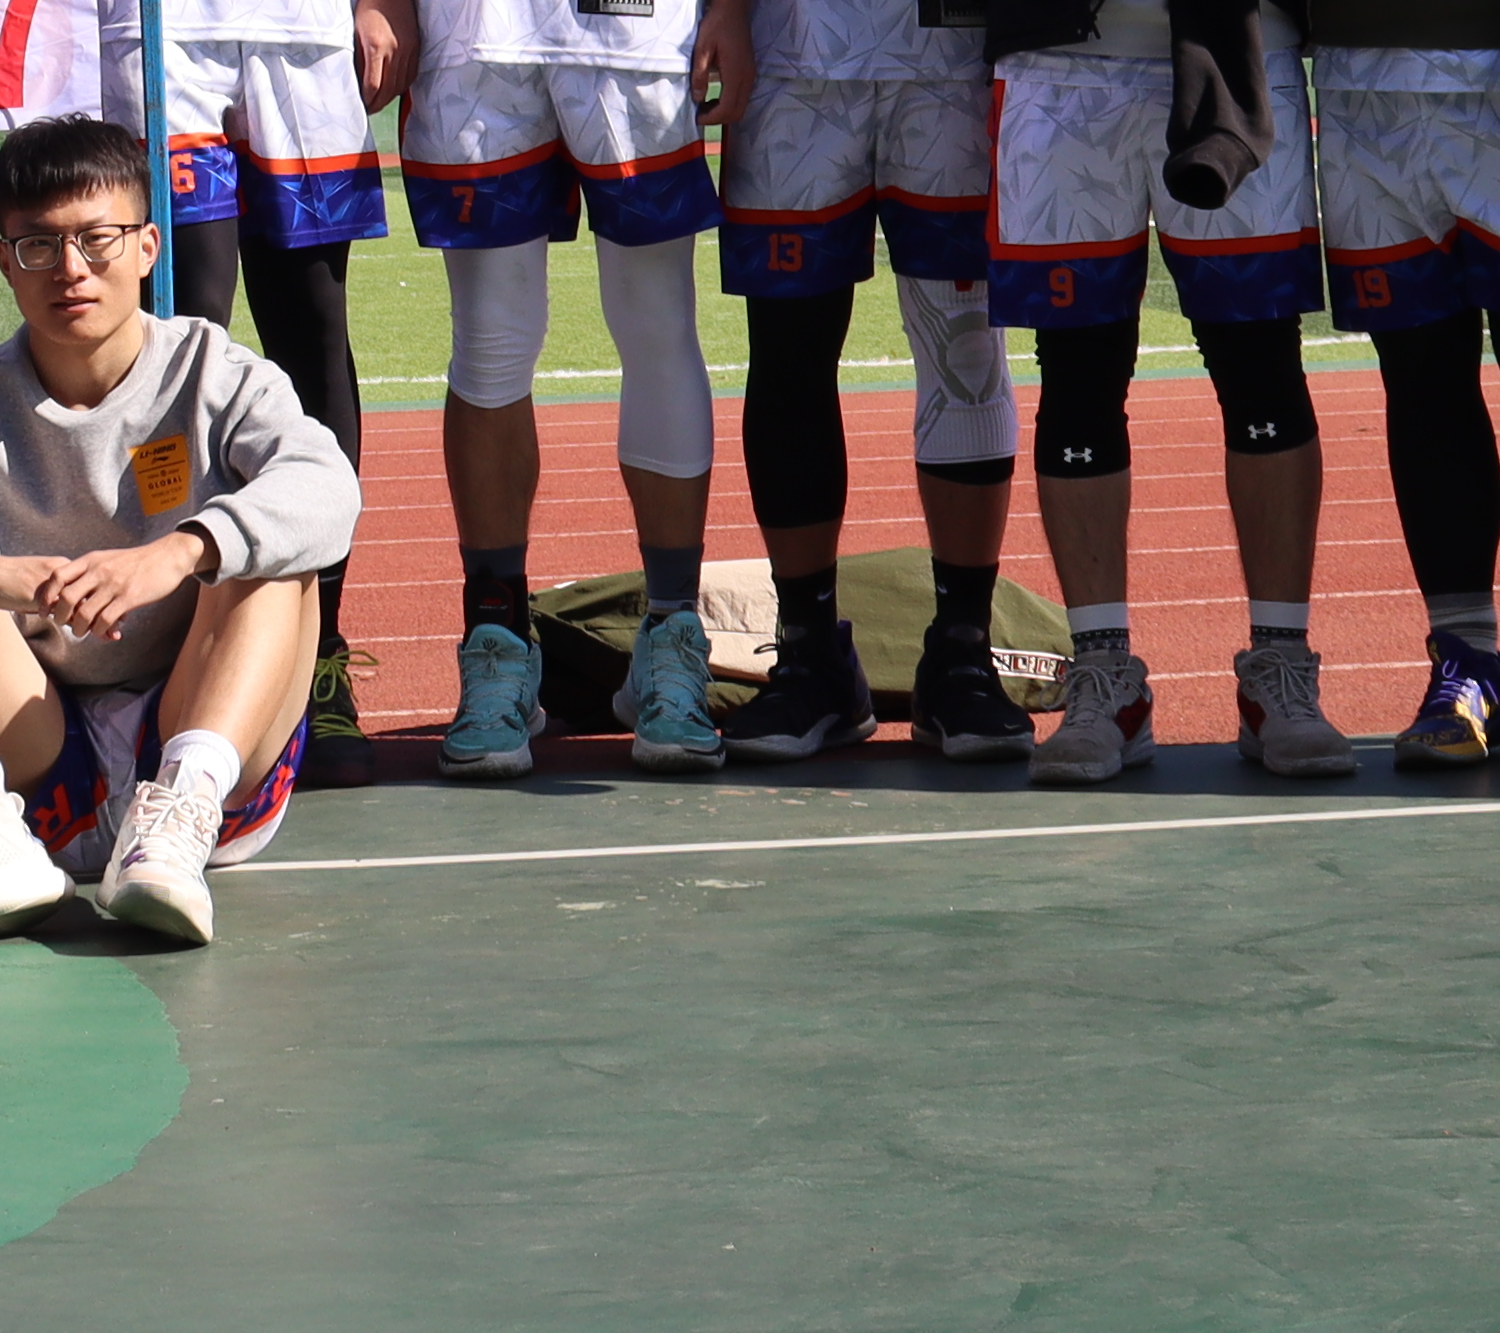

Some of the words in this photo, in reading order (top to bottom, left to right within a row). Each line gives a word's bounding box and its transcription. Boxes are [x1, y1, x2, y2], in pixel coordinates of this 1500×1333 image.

[170, 152, 196, 194] 6
[452, 186, 475, 223] 7
[767, 233, 804, 271] 13
[1049, 267, 1075, 307] 9
[1353, 269, 1392, 308] 19
